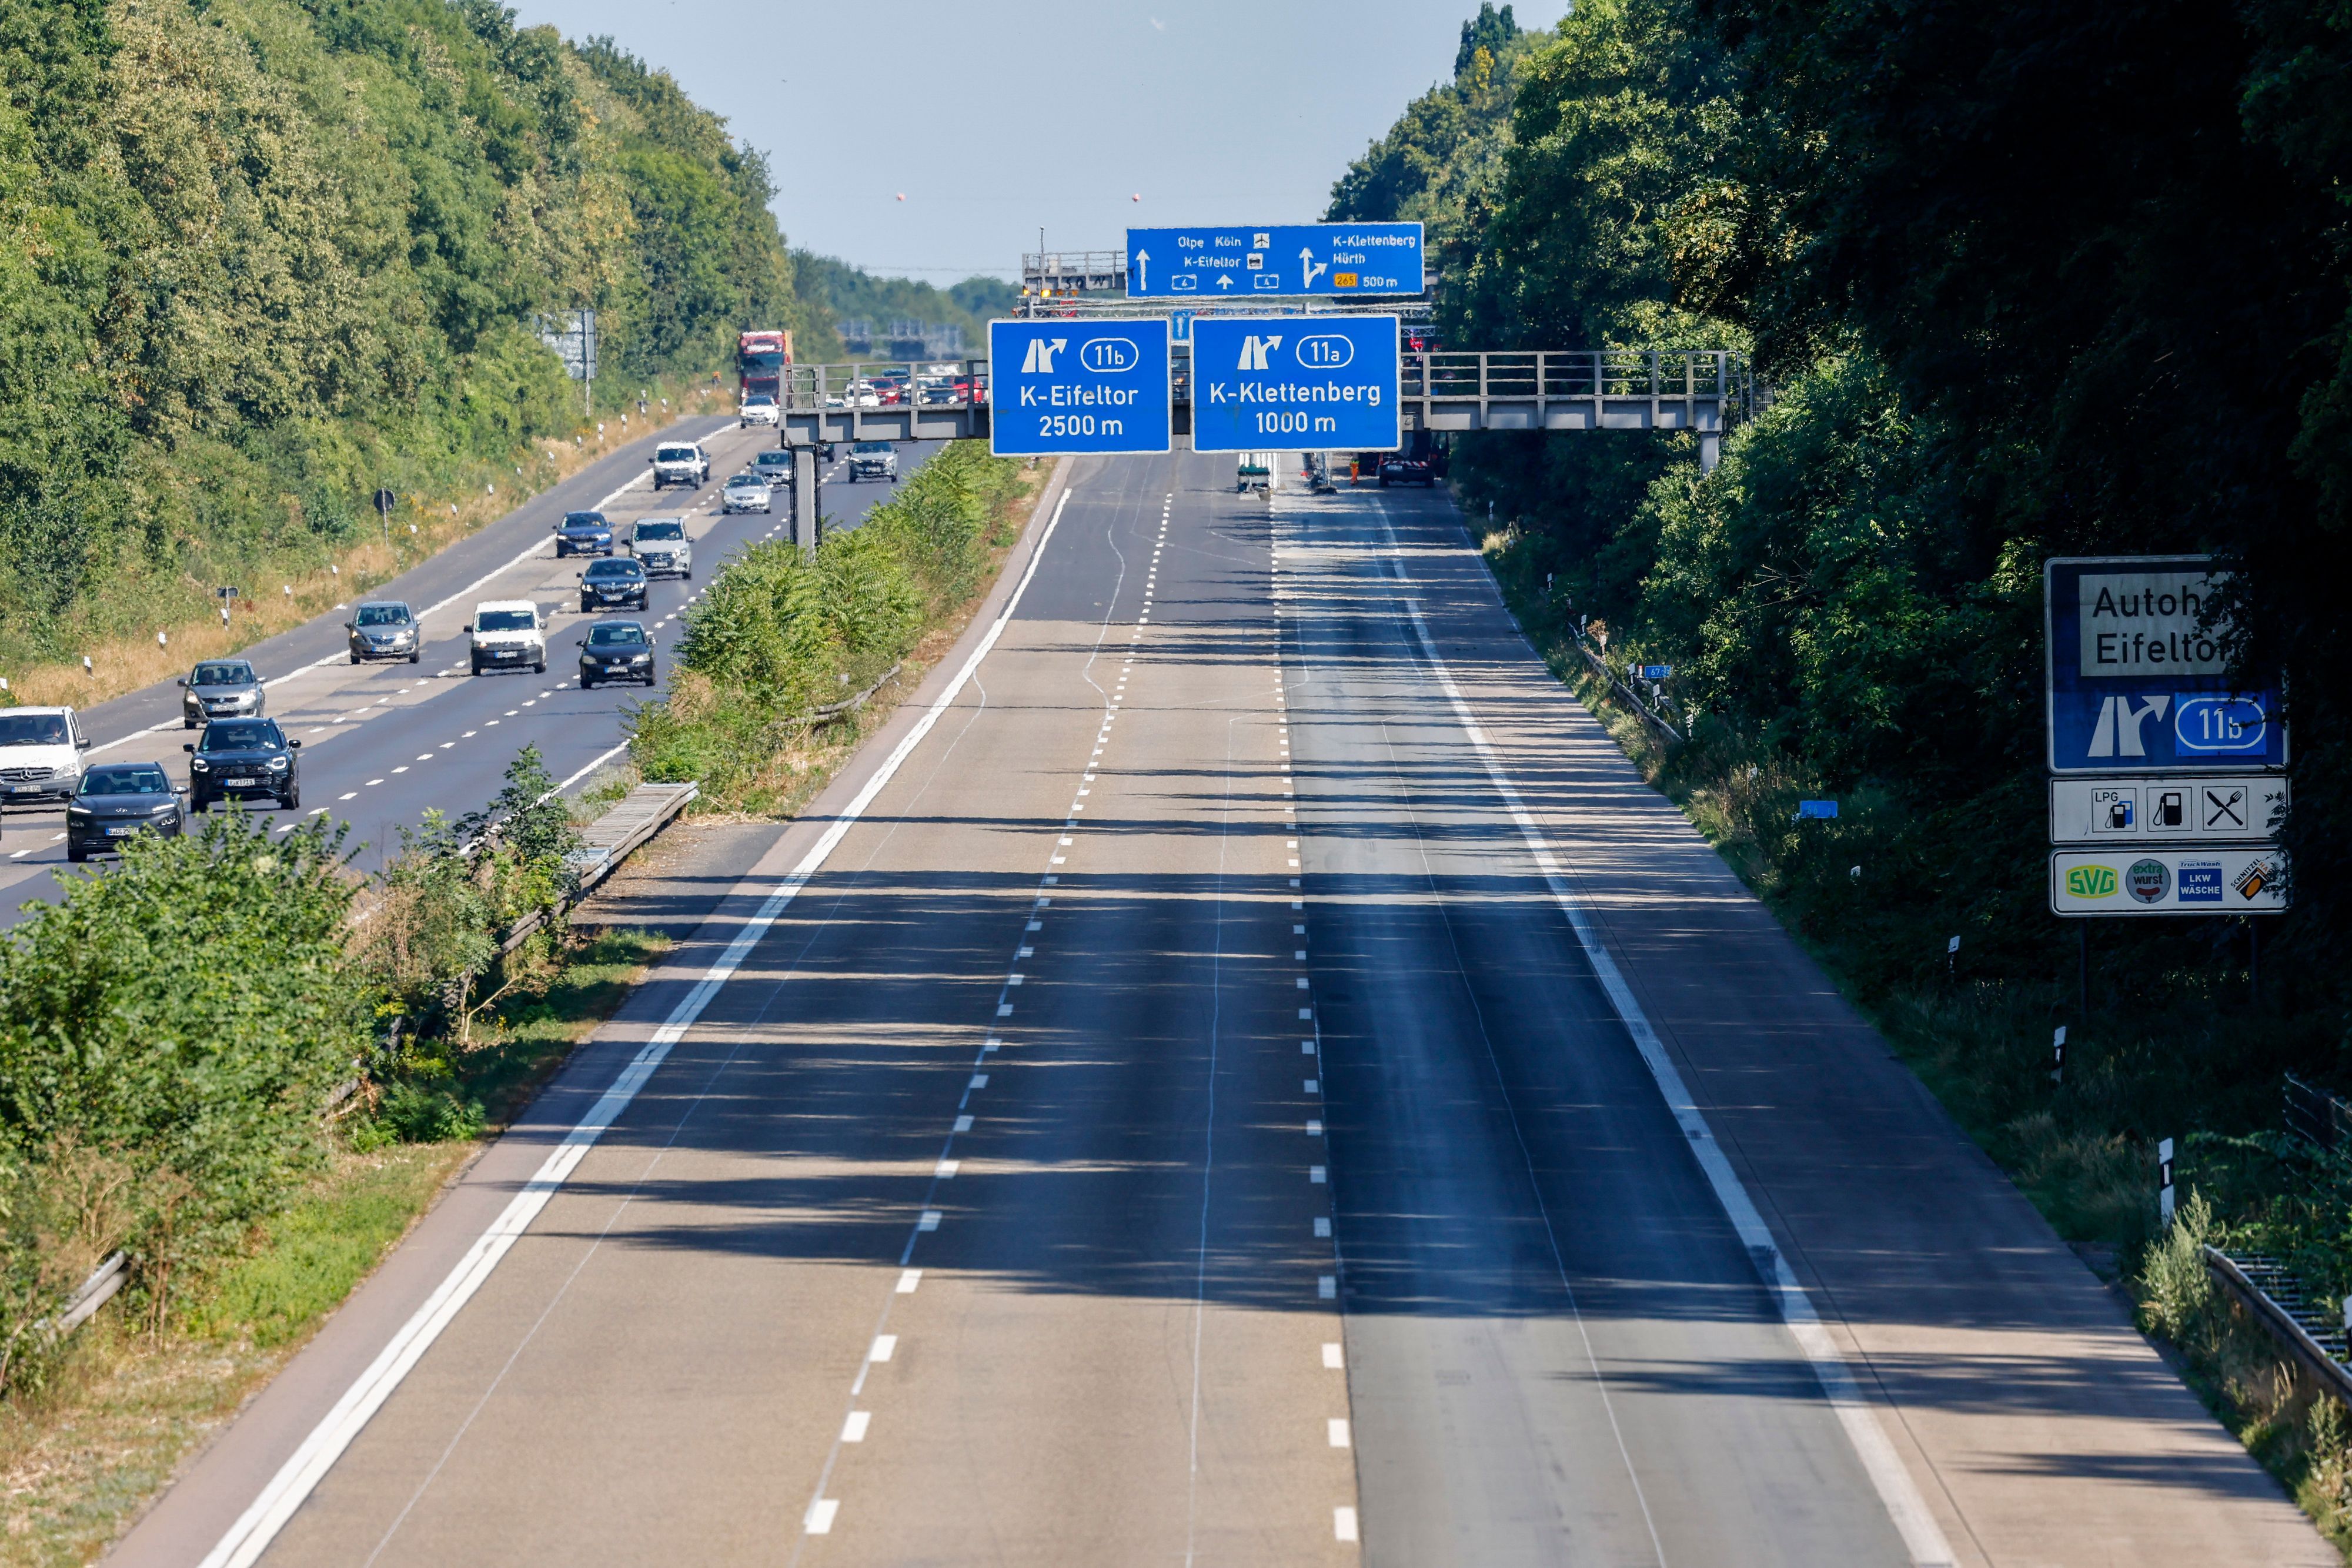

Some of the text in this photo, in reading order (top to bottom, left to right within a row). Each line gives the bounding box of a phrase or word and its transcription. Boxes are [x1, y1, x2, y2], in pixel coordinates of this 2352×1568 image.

[1178, 236, 1242, 250] Olpe Köln
[1333, 235, 1416, 248] K-Klettenberg
[1184, 256, 1242, 268] K-Eifeltor
[1333, 252, 1366, 264] Hürth
[1337, 276, 1398, 287] 265 500 m
[1095, 345, 1124, 366] 11b
[1311, 341, 1339, 362] 11a
[1021, 385, 1139, 406] K-Eifeltor
[1210, 380, 1381, 407] K-Klettenberg
[1039, 415, 1123, 437] 2500 m
[1256, 411, 1336, 433] 1000 m
[2092, 585, 2201, 617] Autoh
[2199, 708, 2242, 739] 11b
[2095, 792, 2119, 802] LPG
[2133, 862, 2163, 874] extra
[2231, 858, 2261, 887] SCHNITZEL
[2070, 869, 2114, 895] SVG
[2133, 874, 2163, 885] wurst
[2189, 874, 2211, 882] LKW
[2180, 884, 2220, 894] WÄSCHE
